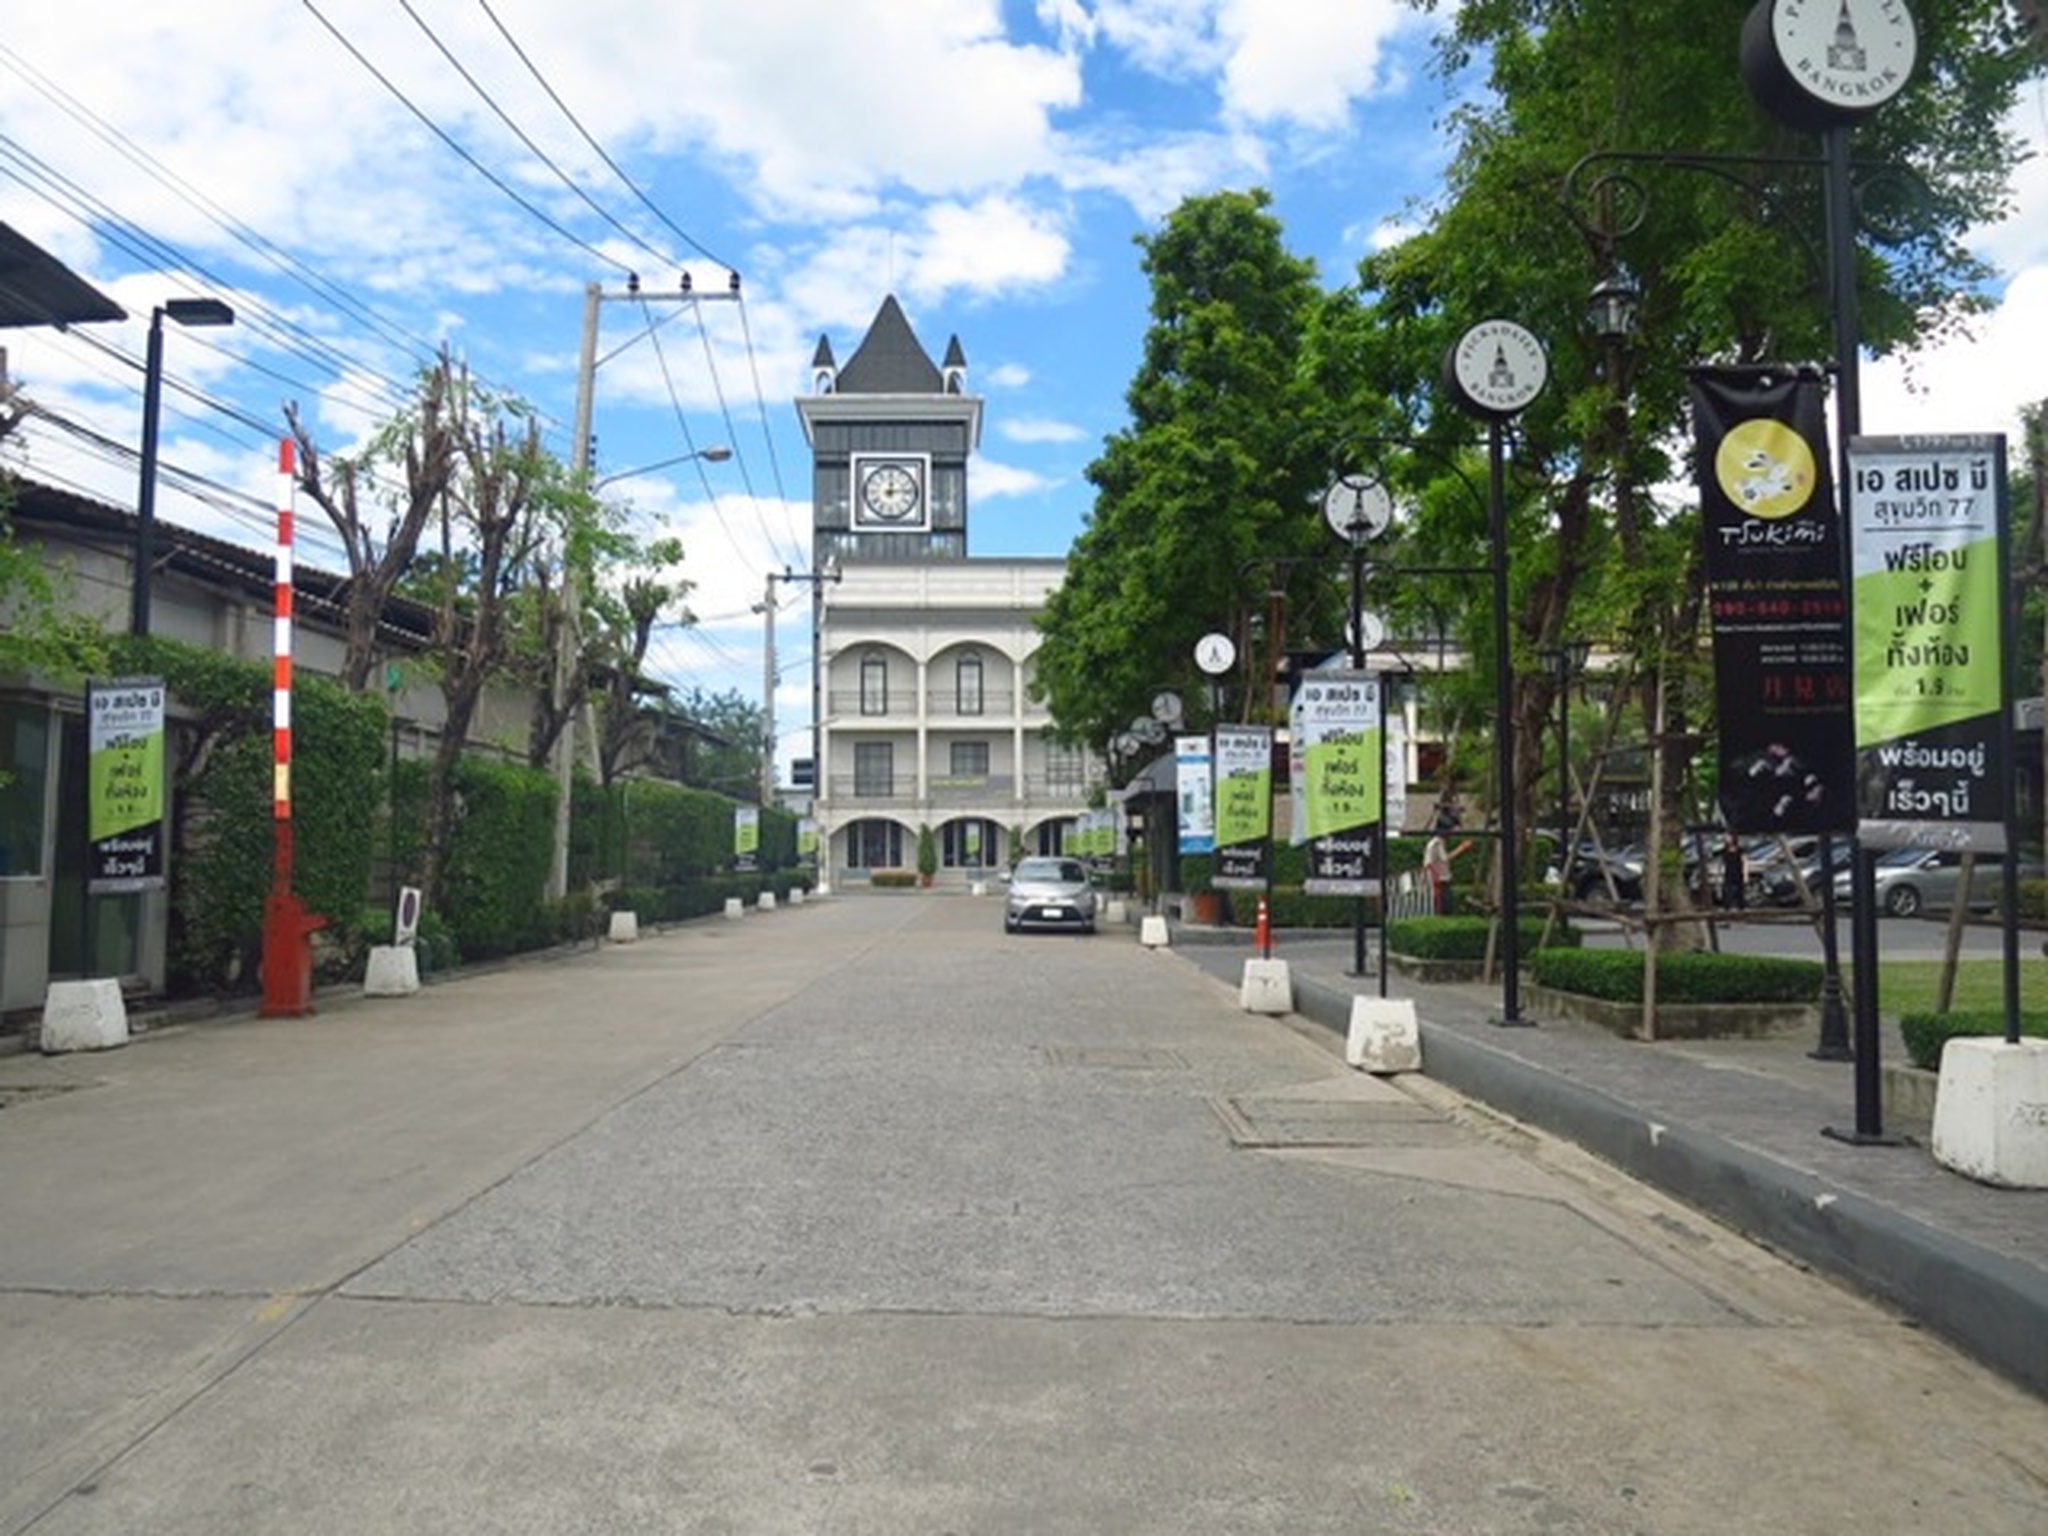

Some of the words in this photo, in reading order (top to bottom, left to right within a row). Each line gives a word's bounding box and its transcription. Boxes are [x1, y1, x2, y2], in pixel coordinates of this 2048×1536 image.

[1797, 56, 1898, 97] BANGKOK
[1470, 382, 1534, 404] BANGKOK
[1856, 469, 1885, 493] เอ
[1894, 461, 1959, 492] สเปซ
[1948, 497, 1976, 518] 77
[1879, 740, 1986, 777] พร้อมอยู่
